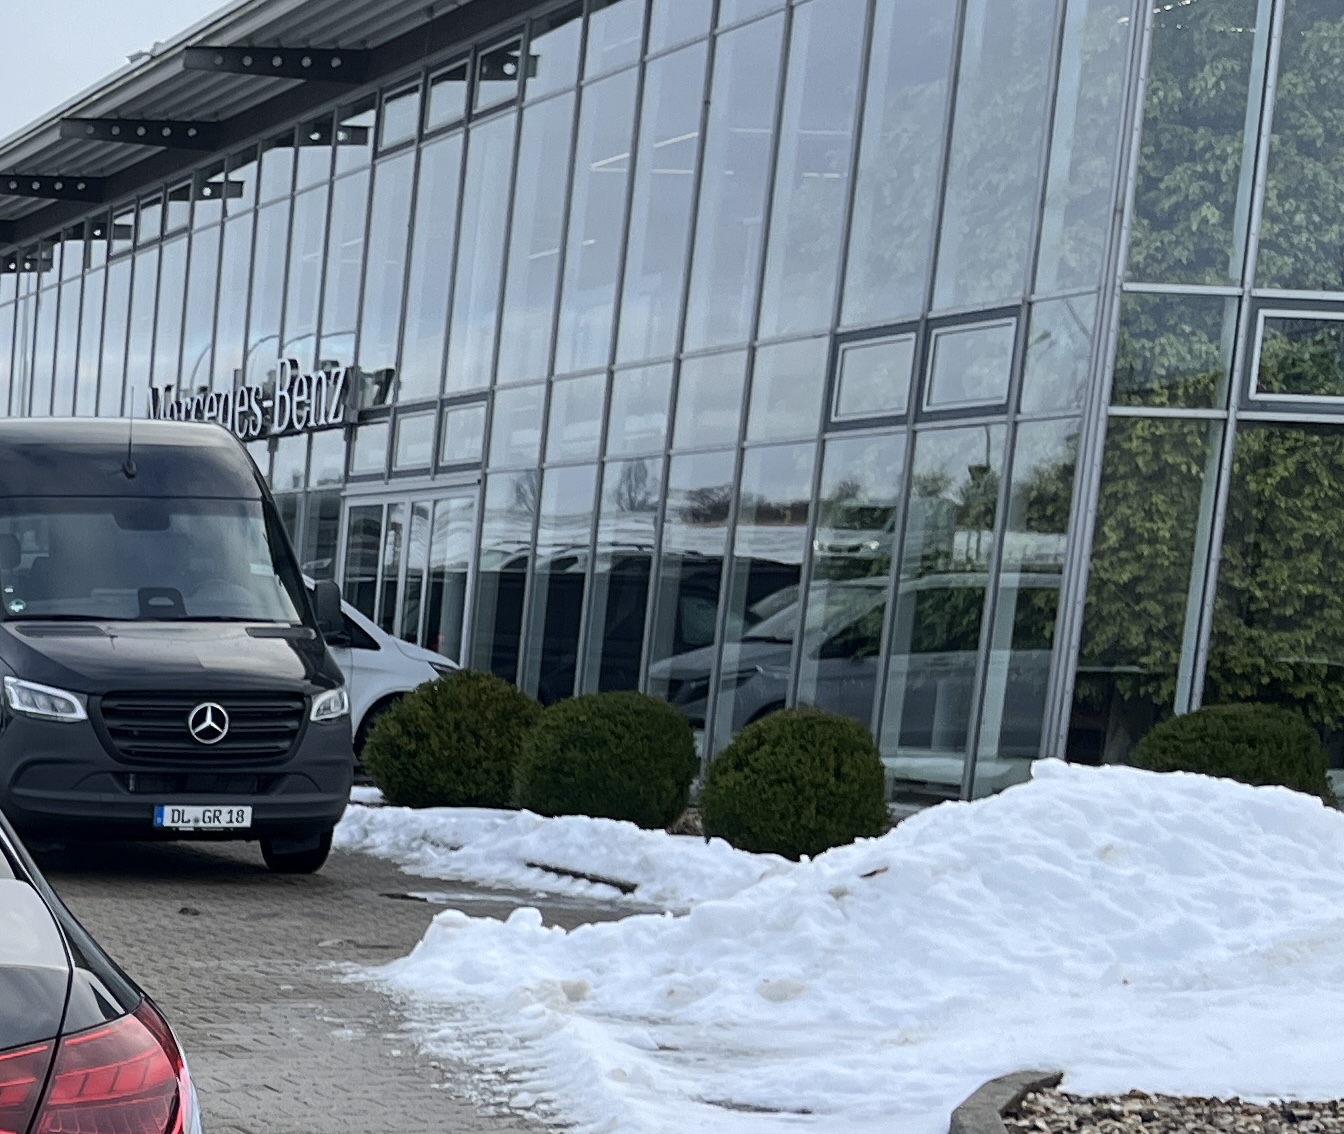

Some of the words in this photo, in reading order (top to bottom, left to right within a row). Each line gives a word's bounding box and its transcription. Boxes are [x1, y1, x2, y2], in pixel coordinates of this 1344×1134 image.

[170, 808, 191, 824] DL
[202, 809, 223, 825] GR
[225, 809, 245, 825] 18
